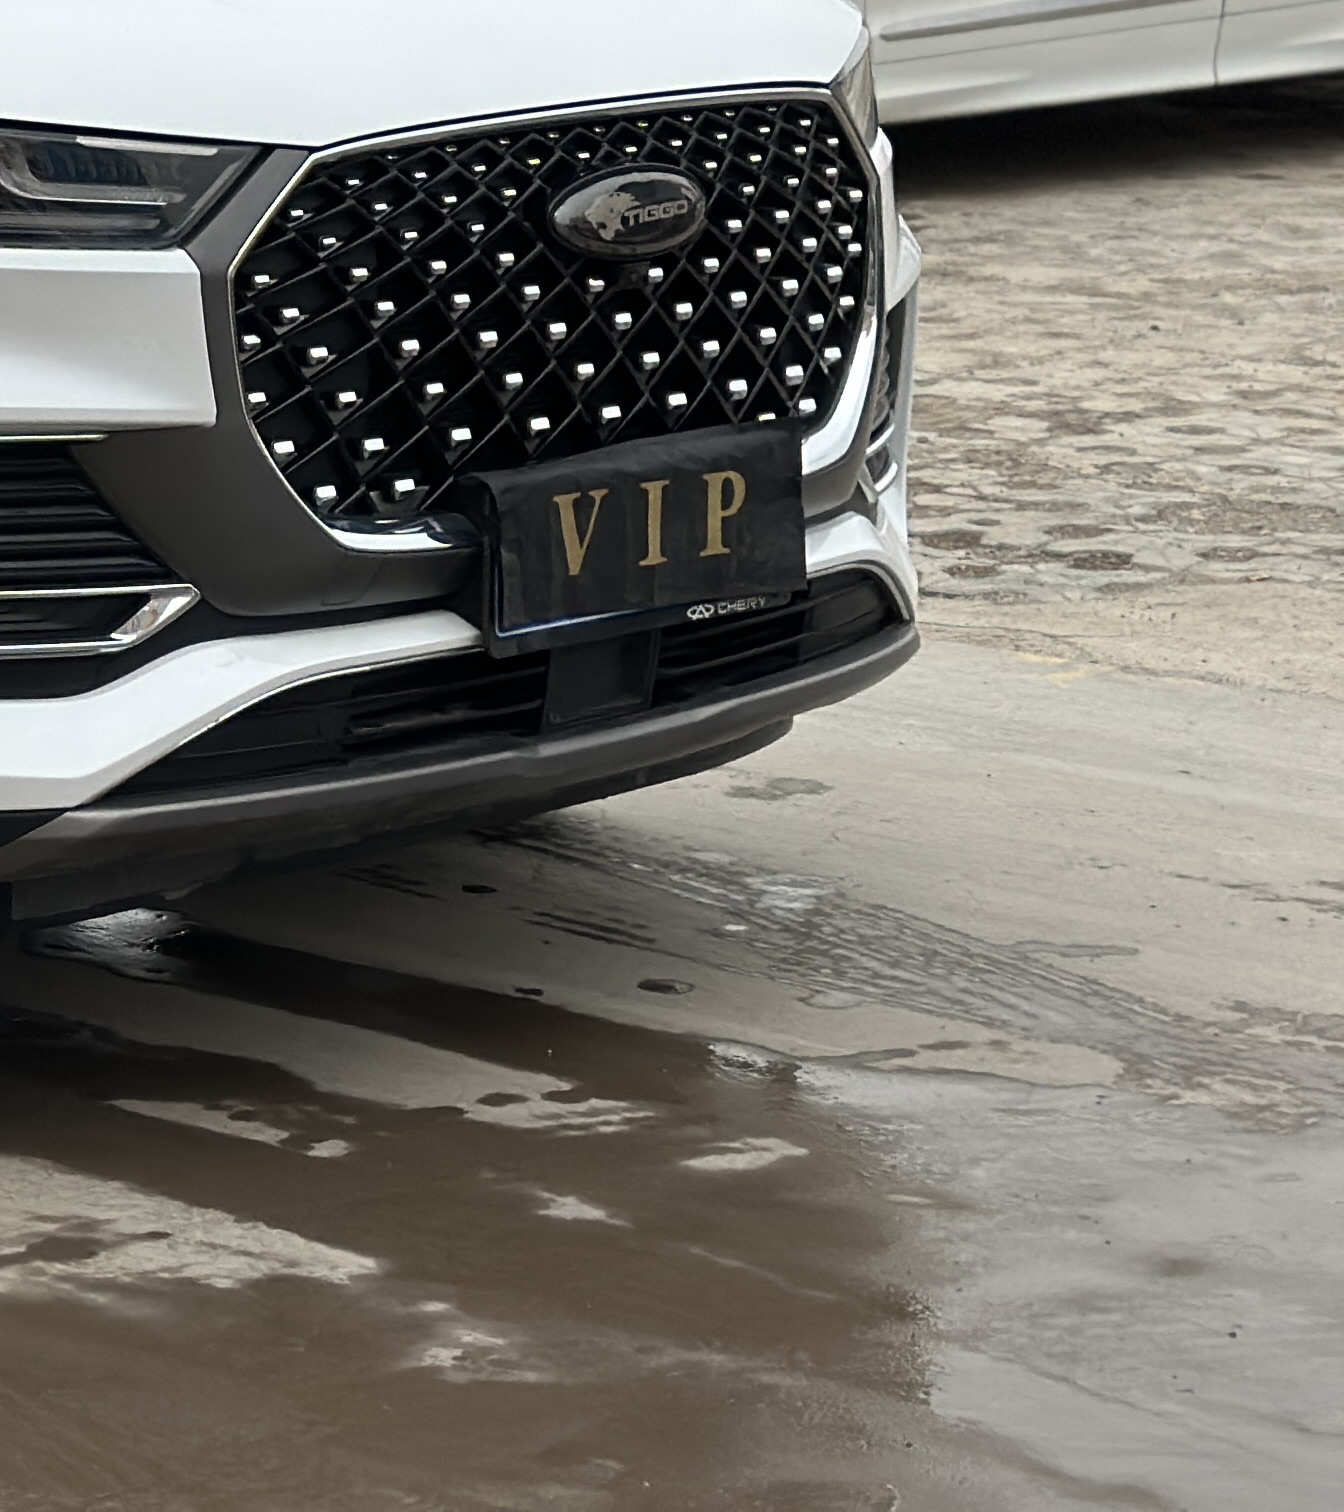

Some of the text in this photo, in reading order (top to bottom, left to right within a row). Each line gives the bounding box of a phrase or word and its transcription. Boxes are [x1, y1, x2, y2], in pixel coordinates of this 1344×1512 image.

[624, 199, 689, 226] TIGGO
[553, 470, 746, 576] VIP
[717, 596, 766, 614] CHERY
